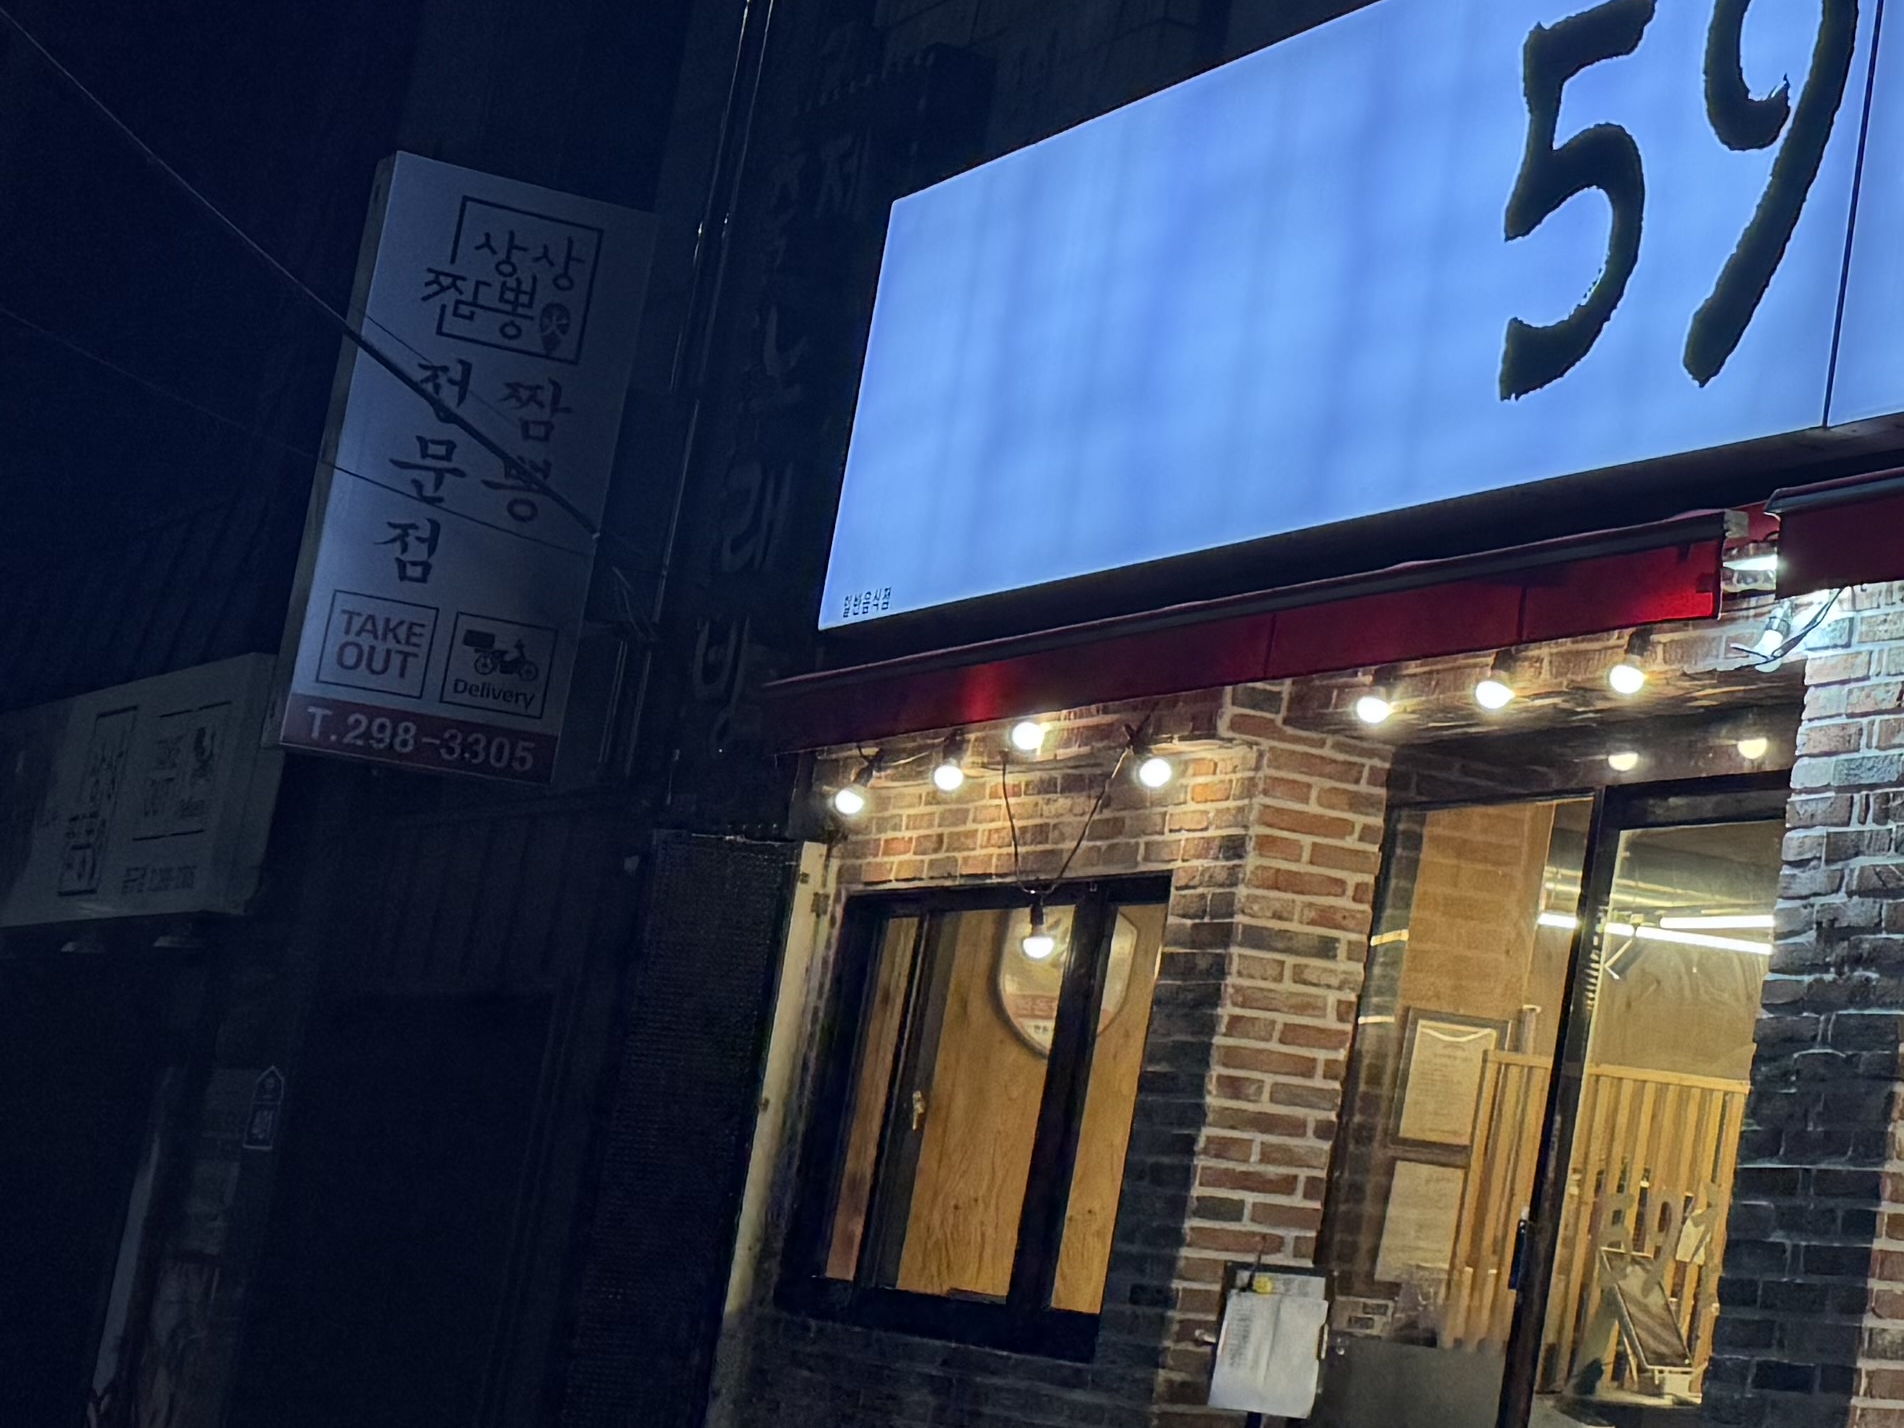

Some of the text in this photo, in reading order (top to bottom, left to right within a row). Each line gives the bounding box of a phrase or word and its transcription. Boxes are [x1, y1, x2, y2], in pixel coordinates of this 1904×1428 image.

[474, 229, 585, 292] 상상
[421, 267, 537, 340] 짬뽕
[480, 377, 574, 523] 짬뽕
[842, 586, 893, 619] 일반음식점
[340, 609, 426, 649] TAKE
[336, 641, 419, 679] OUT
[453, 678, 535, 710] Delivery
[307, 705, 536, 773] T.298-3305
